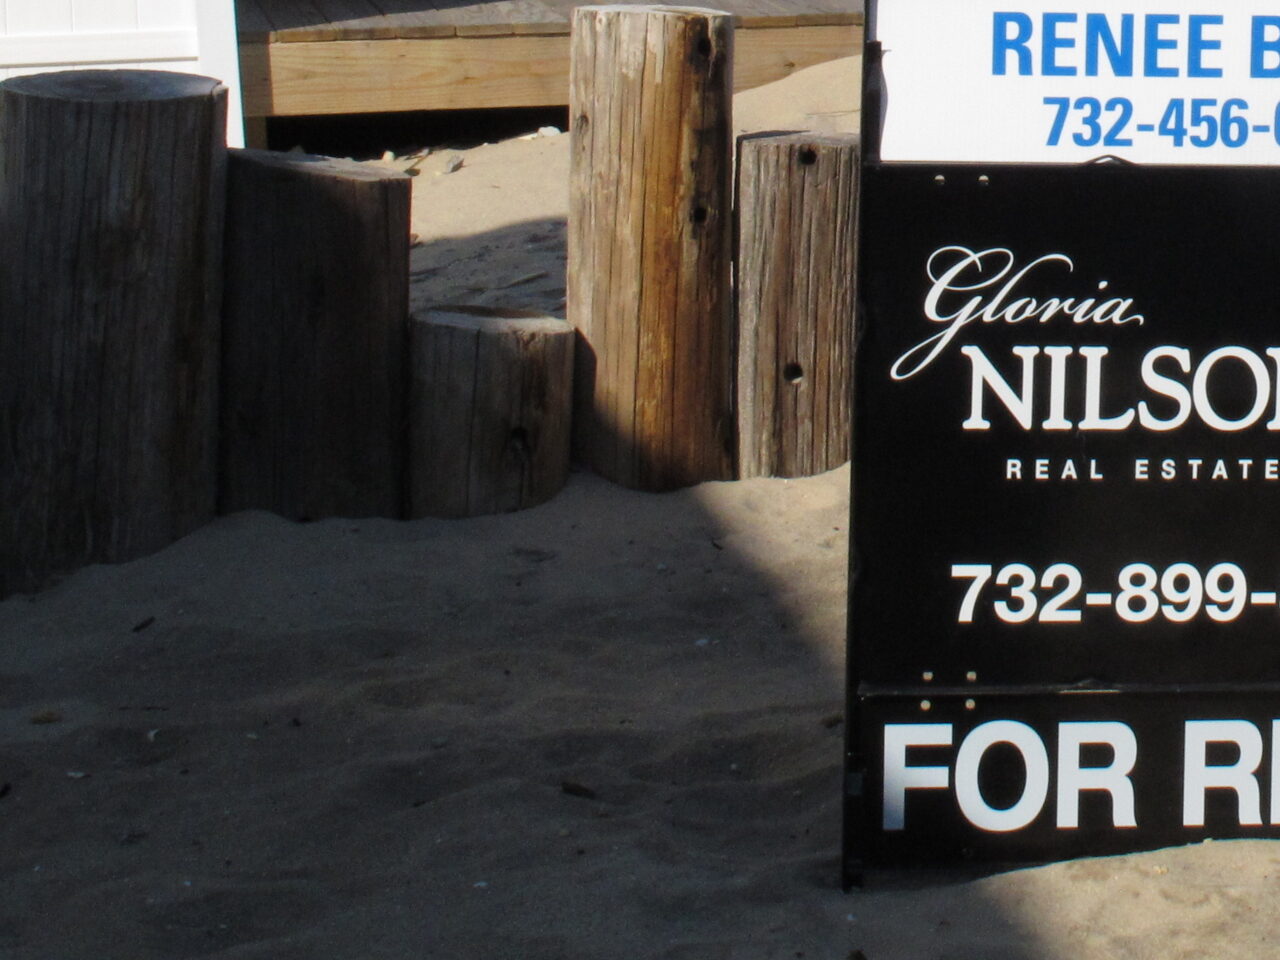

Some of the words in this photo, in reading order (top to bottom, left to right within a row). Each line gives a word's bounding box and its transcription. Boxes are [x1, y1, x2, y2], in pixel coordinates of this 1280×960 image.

[992, 11, 1224, 78] RENEE
[890, 245, 1145, 381] Gloria
[1006, 458, 1104, 480] REAL
[1134, 458, 1280, 480] ESTATE
[882, 719, 1138, 832] FOR
